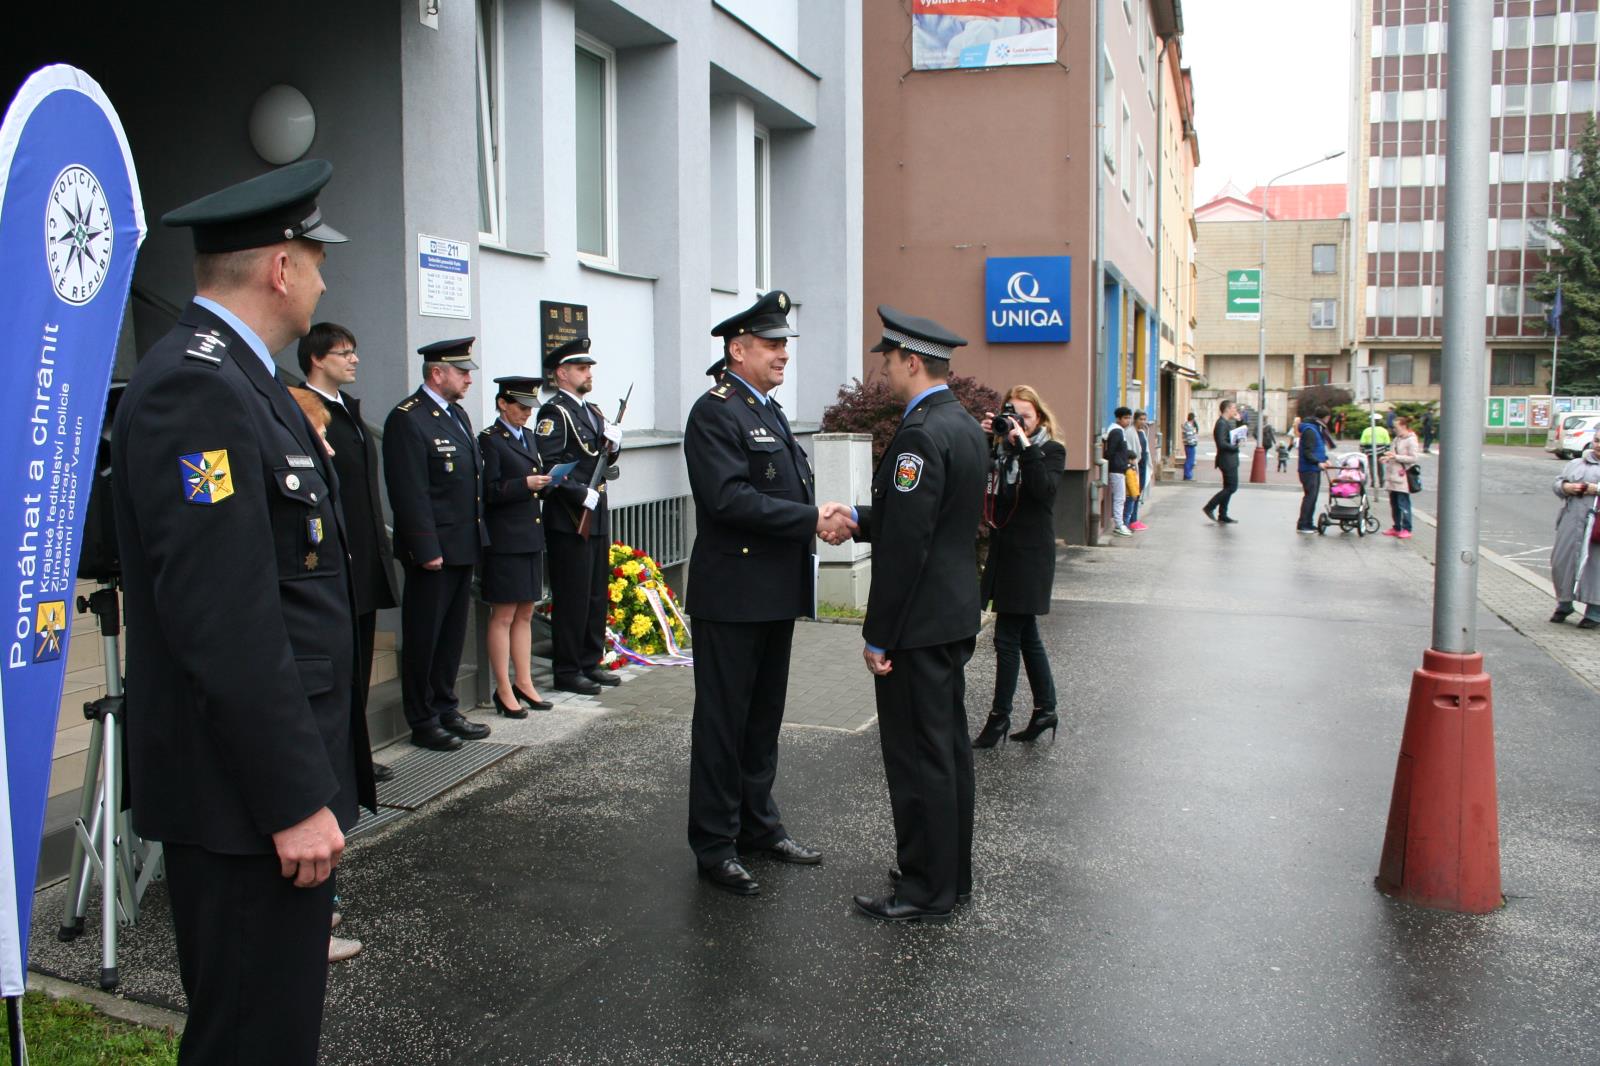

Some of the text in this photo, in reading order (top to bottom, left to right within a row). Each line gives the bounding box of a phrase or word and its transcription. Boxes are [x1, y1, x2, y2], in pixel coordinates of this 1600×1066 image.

[53, 172, 98, 203] POLICIE
[72, 207, 109, 298] REPUBLIKY
[447, 244, 459, 257] 211
[992, 309, 1063, 327] UNIQA
[9, 323, 59, 669] Pomáhat a chránit
[40, 383, 70, 593] Krajské ředitelství policie
[51, 462, 71, 593] Zlínského kraje
[59, 416, 83, 591] Územní odbor Vsetín
